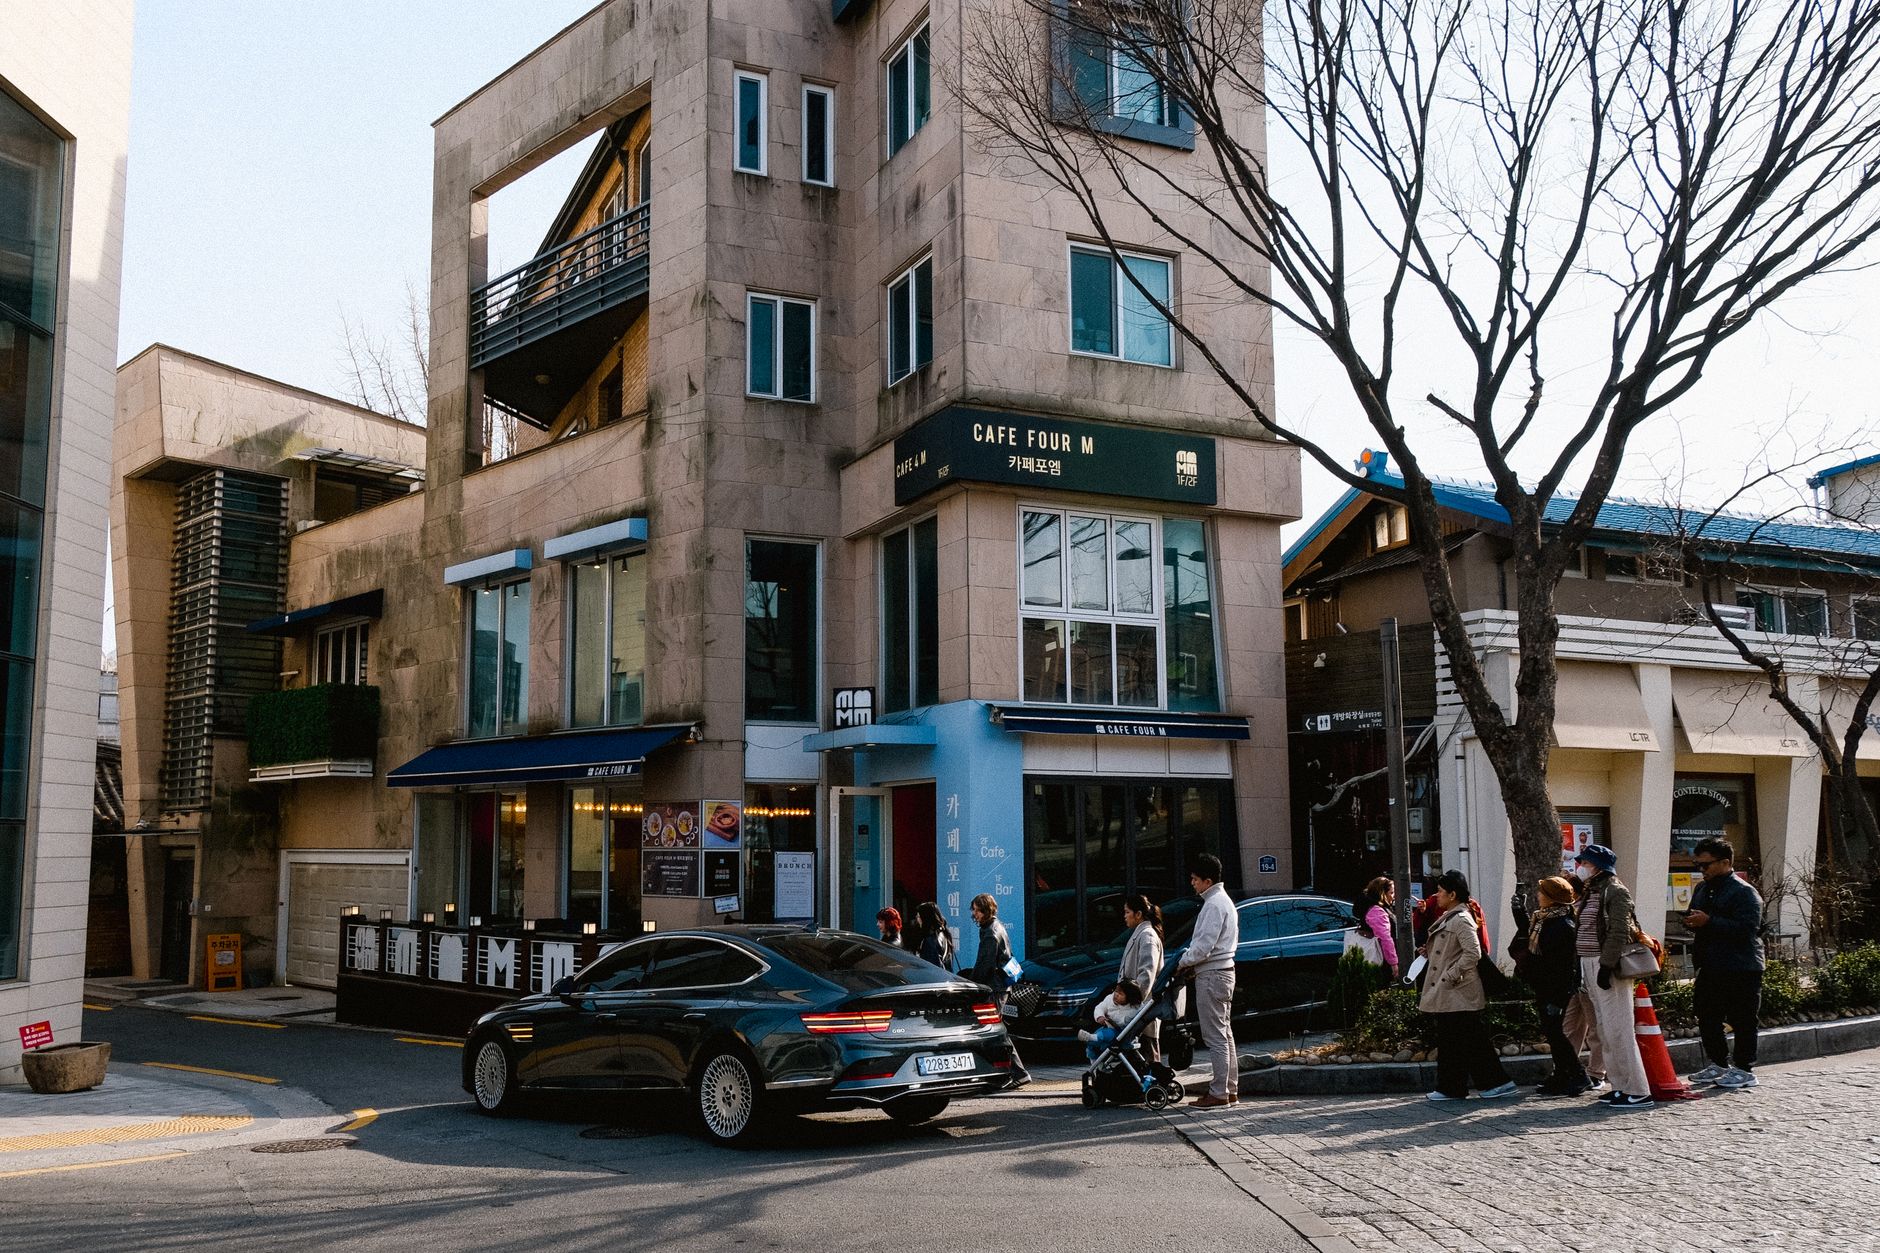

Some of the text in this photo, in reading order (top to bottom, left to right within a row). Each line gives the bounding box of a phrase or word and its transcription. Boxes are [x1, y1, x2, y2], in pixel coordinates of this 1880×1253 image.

[973, 423, 1094, 455] CAFE FOUR M
[896, 457, 913, 478] CAFE
[920, 449, 927, 466] M
[1008, 455, 1061, 476] 카페포엠
[1176, 474, 1198, 487] 1F/2F
[1107, 724, 1167, 736] CAFE FOUR M
[594, 764, 633, 776] CAFE FOUR M
[1673, 786, 1731, 808] CONTEUR STORY
[979, 837, 989, 845] 2F
[946, 793, 960, 917] 카페포엠
[980, 845, 1005, 858] Cafe
[1261, 863, 1275, 871] 19-4
[995, 874, 1003, 882] 1F
[995, 883, 1013, 895] Bar
[951, 1055, 973, 1069] 3471
